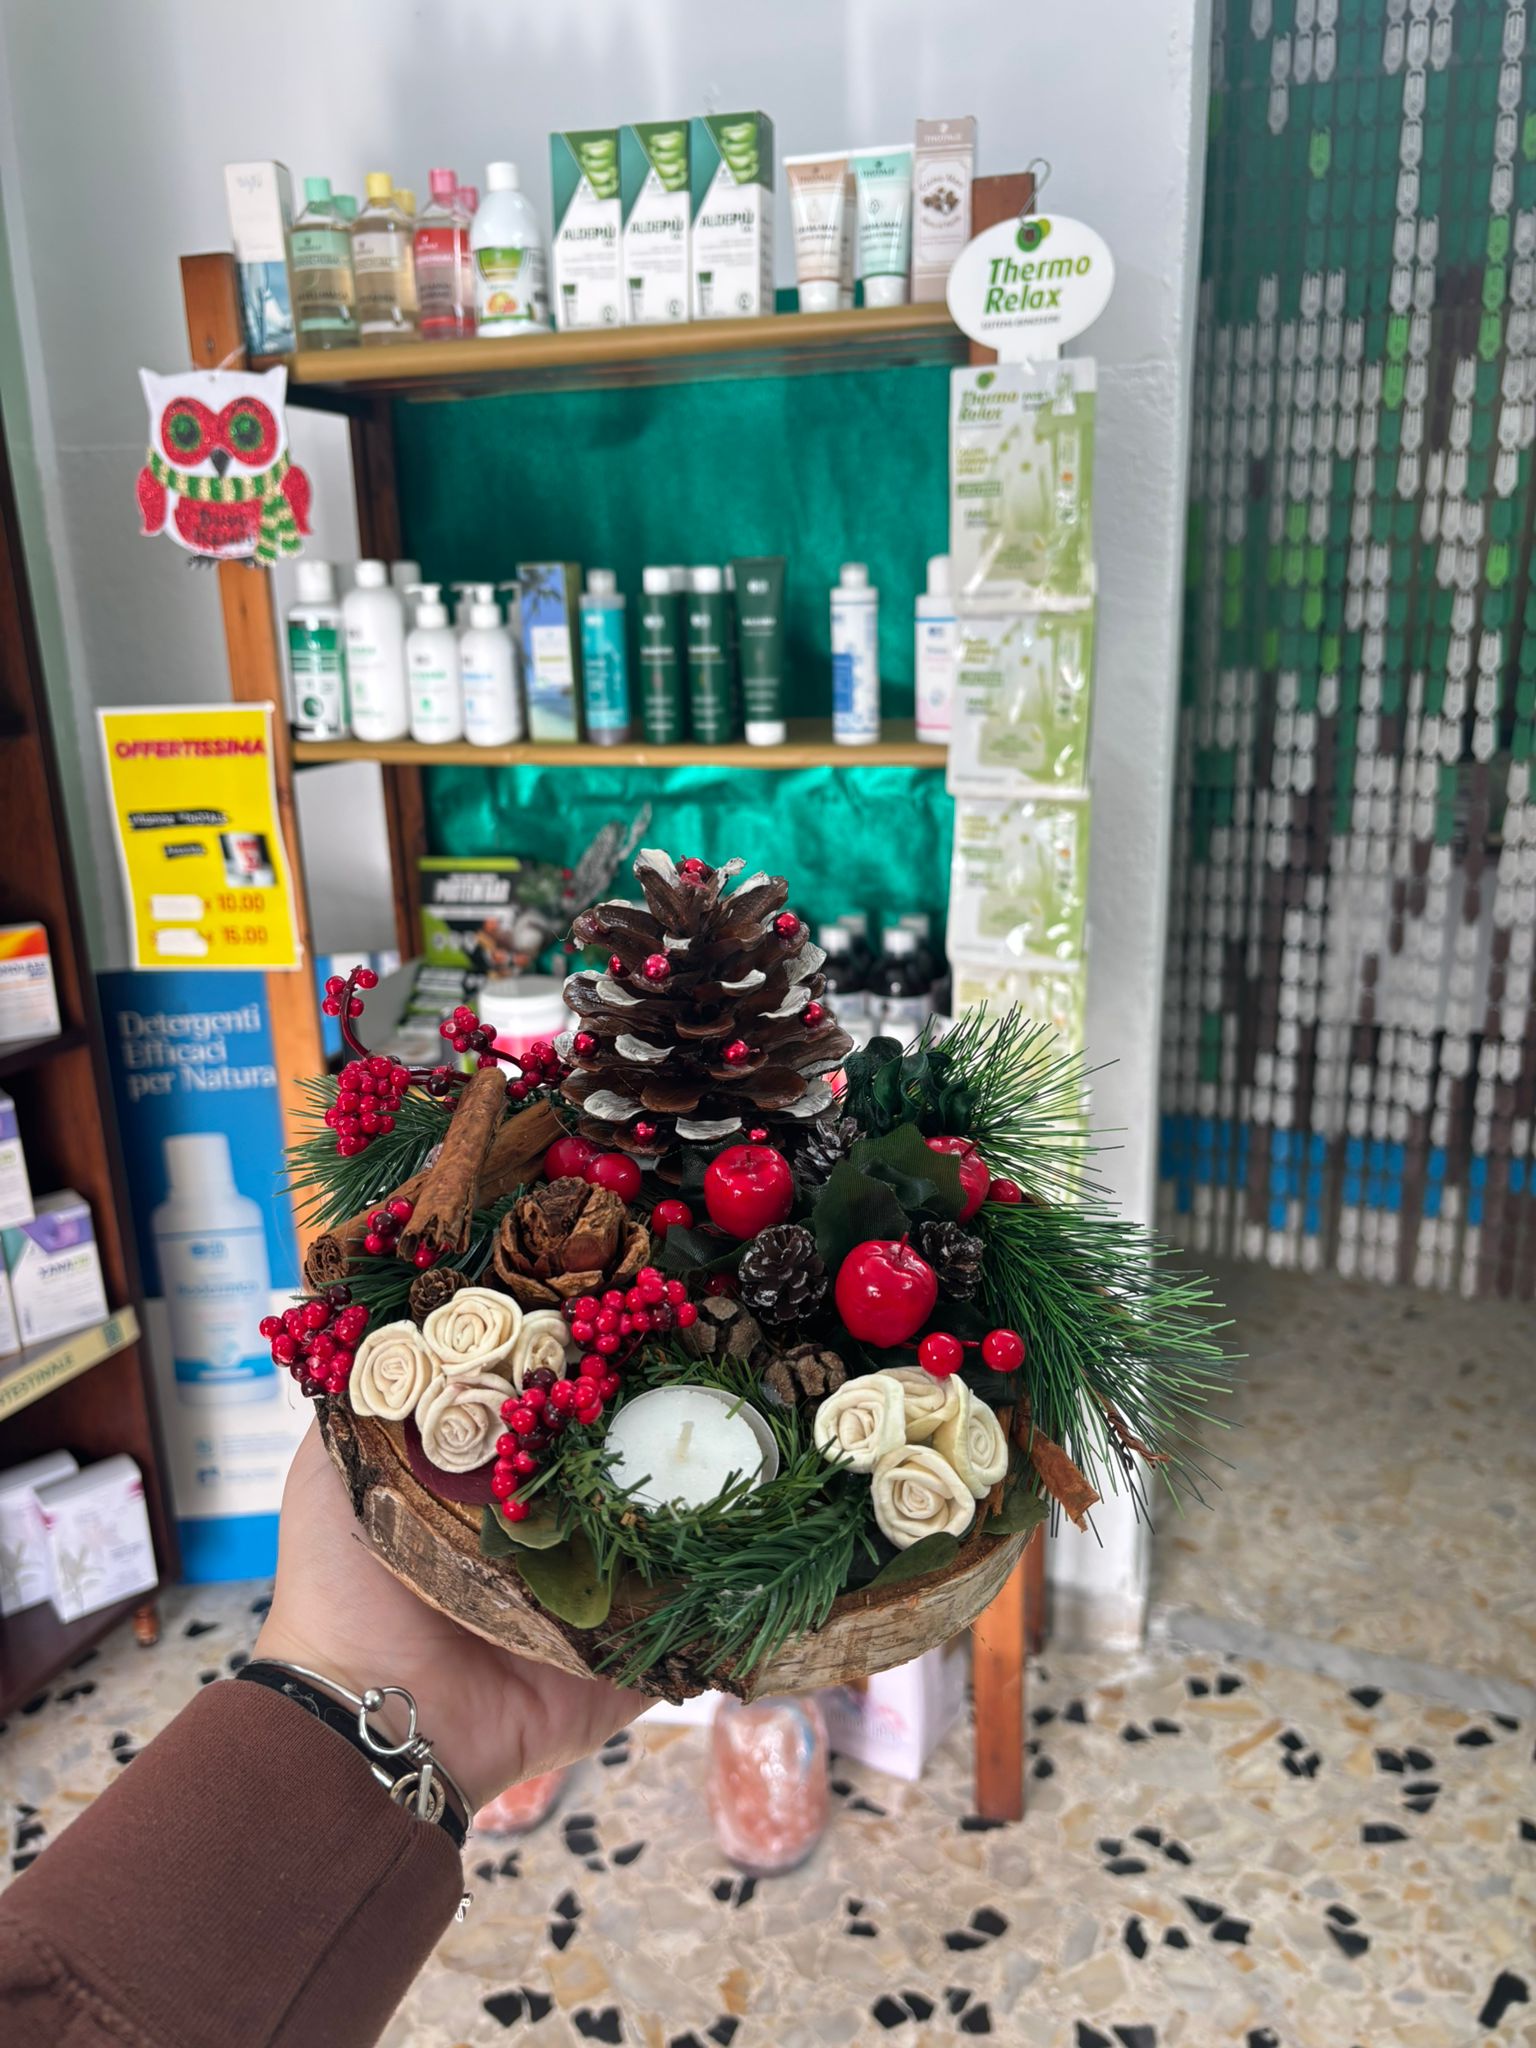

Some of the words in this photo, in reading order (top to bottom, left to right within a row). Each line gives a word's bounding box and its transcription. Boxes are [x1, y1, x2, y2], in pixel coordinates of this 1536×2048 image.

[989, 256, 1091, 285] Thermo
[984, 284, 1061, 315] Relax
[115, 738, 265, 760] OFFERTISSIMA
[119, 1003, 260, 1039] Detergenti
[124, 1034, 227, 1068] Efficaci
[129, 1072, 176, 1102] per
[181, 1065, 277, 1091] Natura
